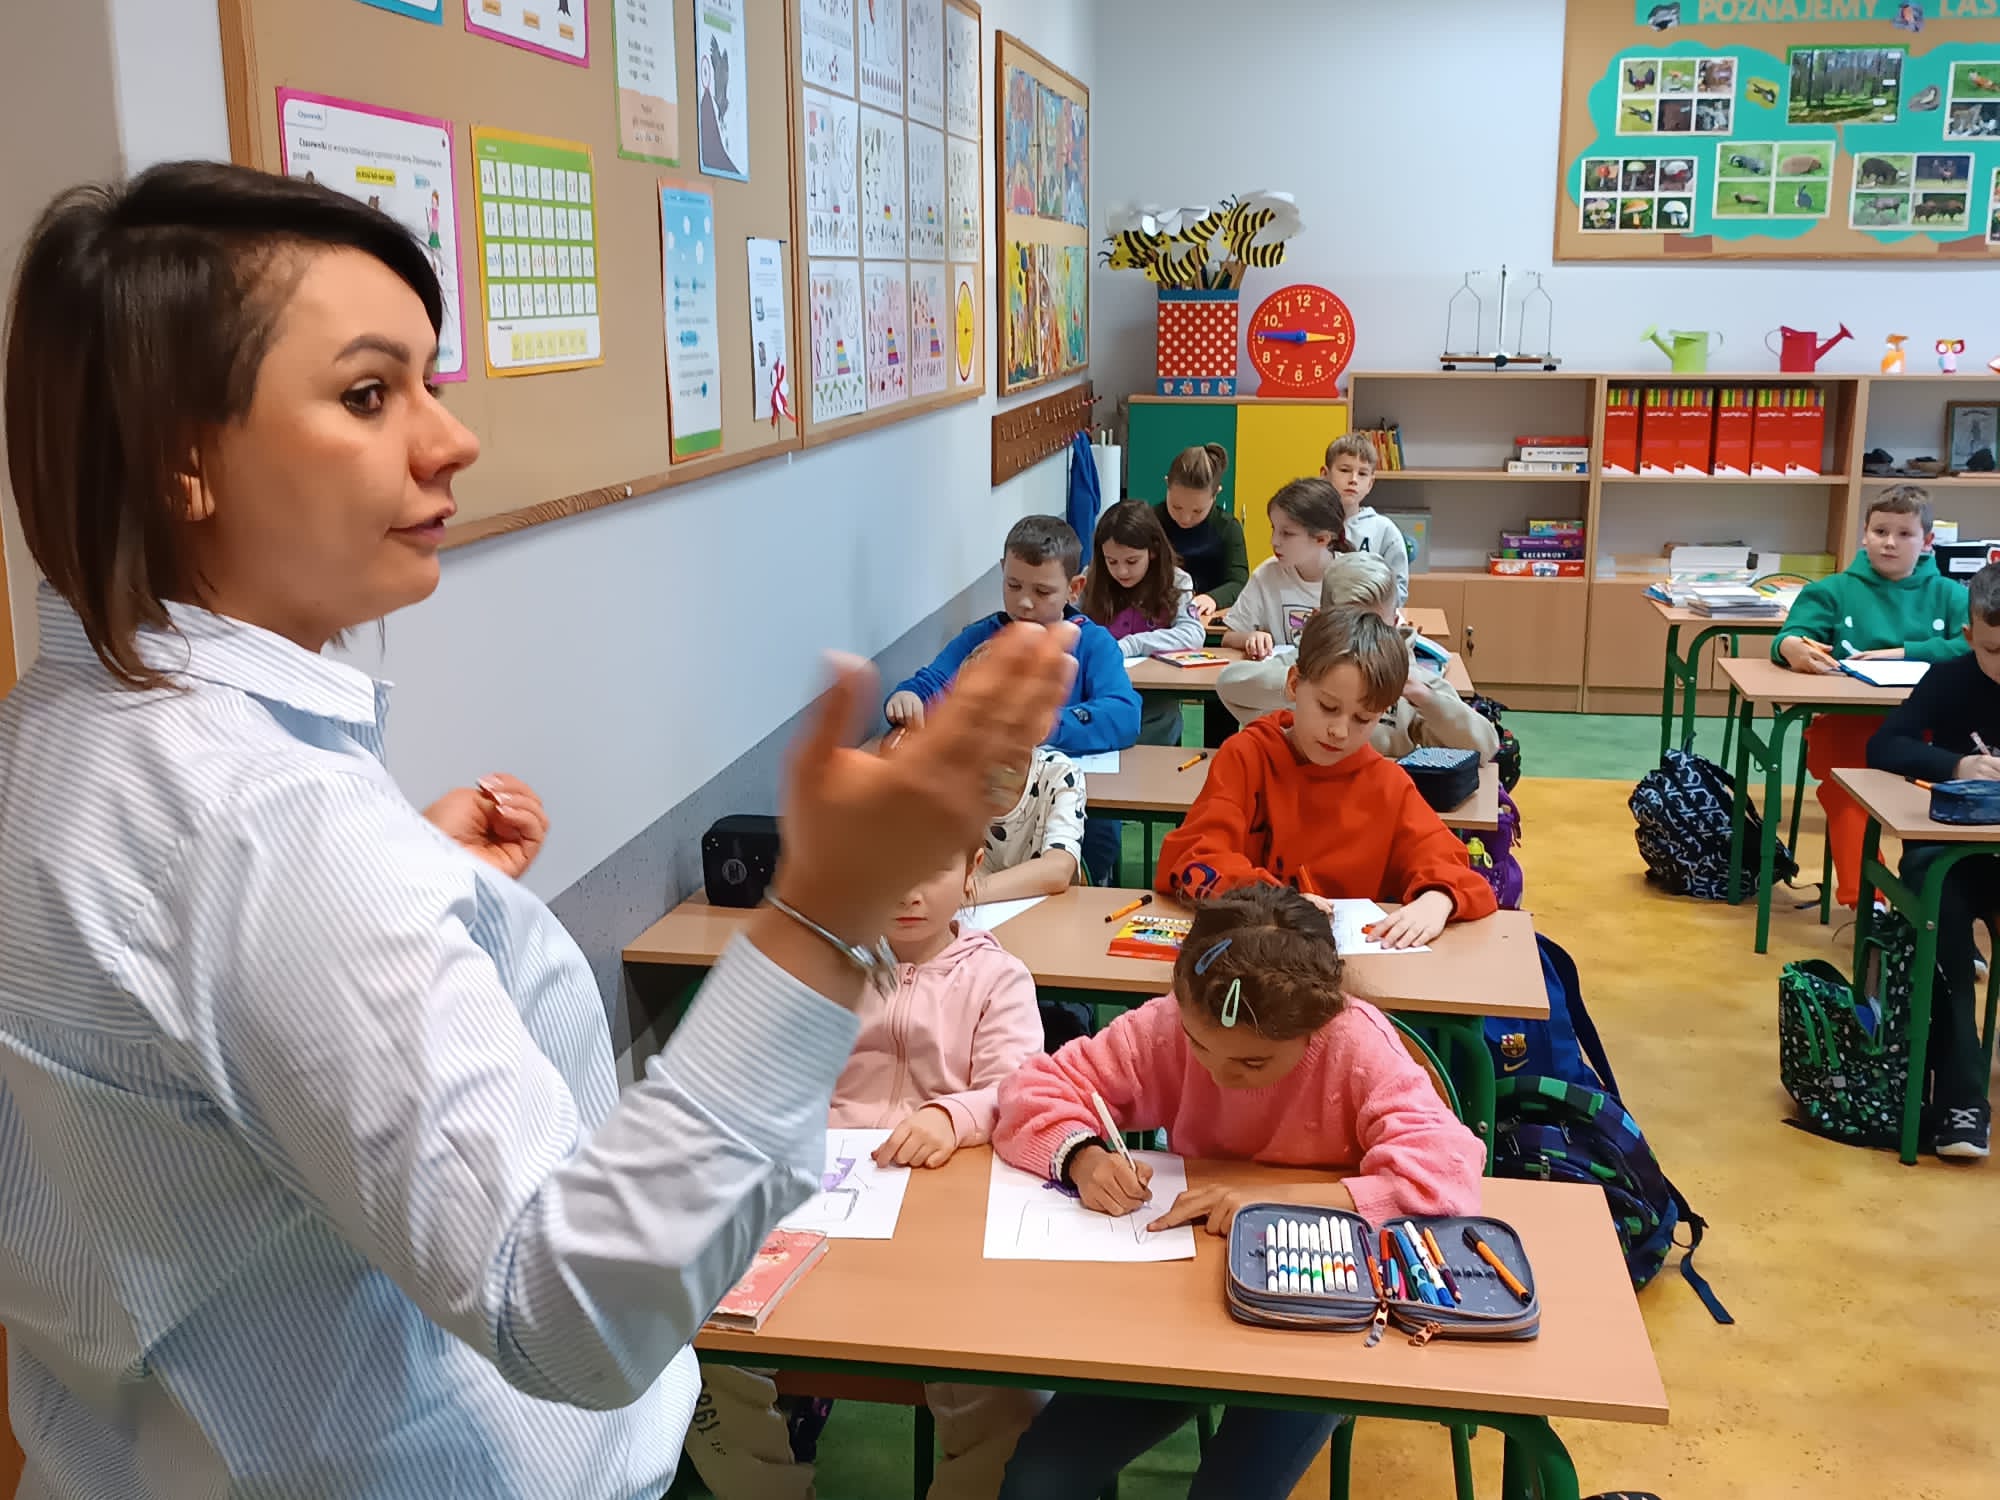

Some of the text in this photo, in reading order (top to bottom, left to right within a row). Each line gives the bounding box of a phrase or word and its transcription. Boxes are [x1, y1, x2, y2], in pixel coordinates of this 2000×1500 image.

[1698, 0, 1879, 22] POZNAJEMY
[1277, 301, 1290, 312] 11
[1297, 294, 1311, 307] 12
[1320, 301, 1326, 312] 1
[1264, 315, 1278, 327] 10
[1333, 315, 1342, 327] 2
[1337, 332, 1346, 345] 3
[1262, 352, 1271, 363] 8
[1329, 352, 1337, 364] 4
[1277, 365, 1285, 376] 7
[1295, 369, 1303, 382] 6
[1314, 365, 1322, 378] 5
